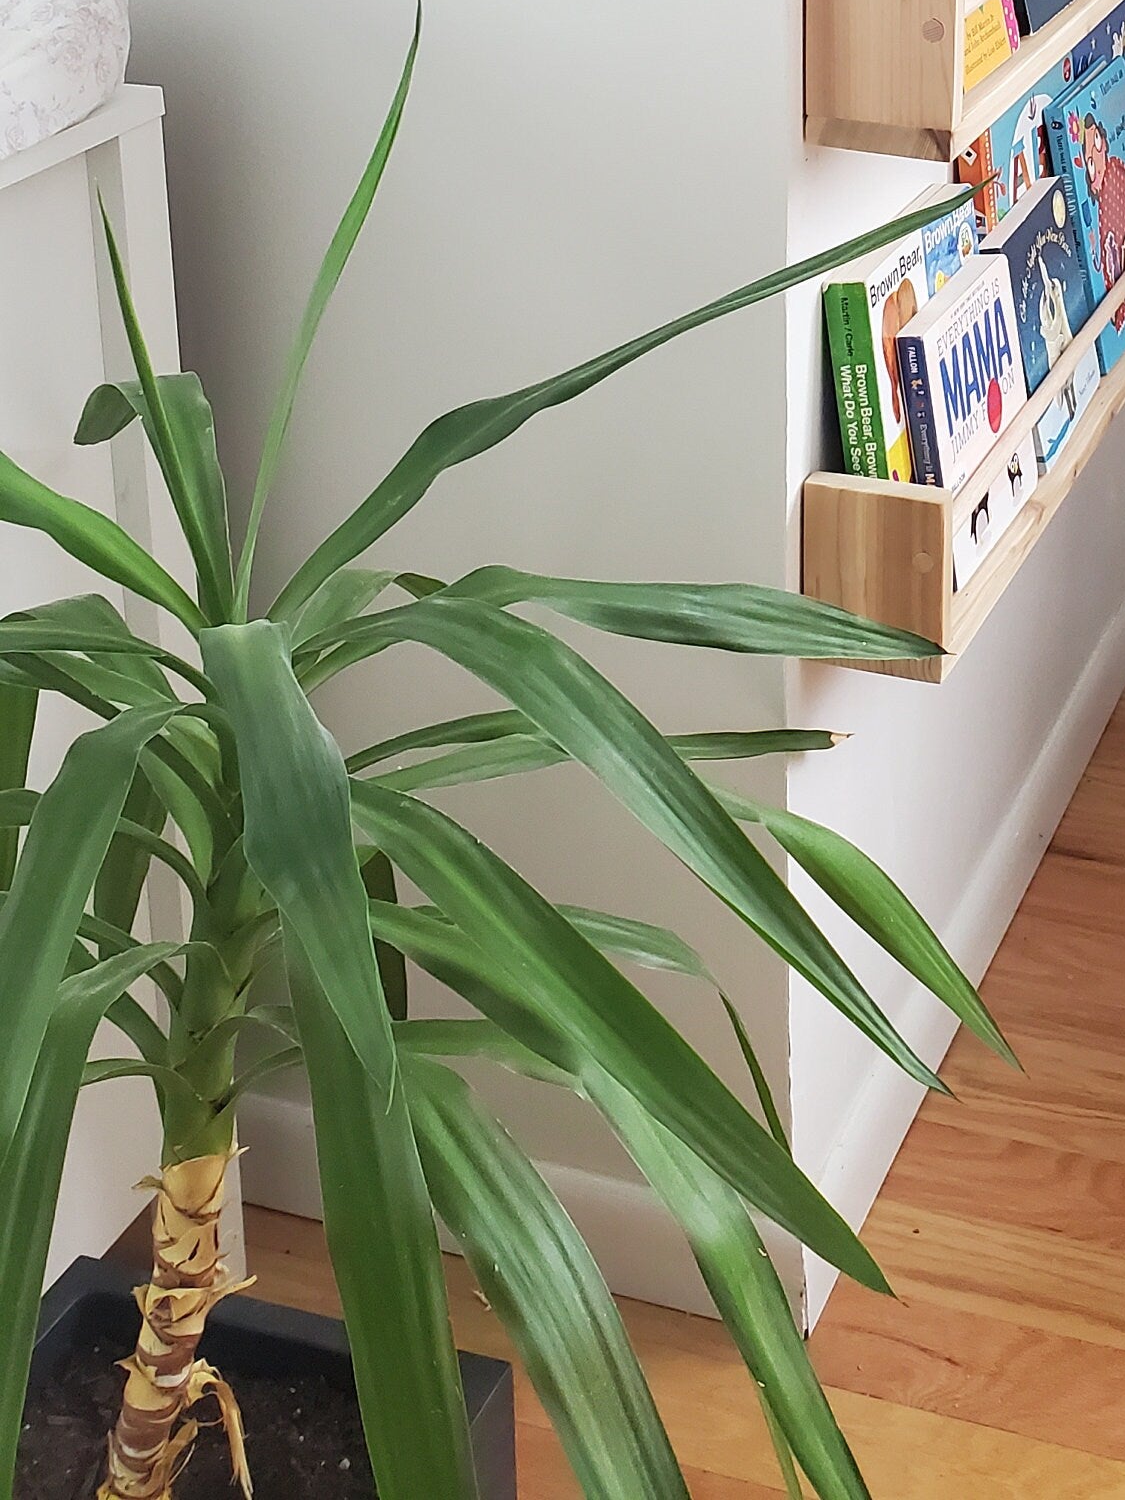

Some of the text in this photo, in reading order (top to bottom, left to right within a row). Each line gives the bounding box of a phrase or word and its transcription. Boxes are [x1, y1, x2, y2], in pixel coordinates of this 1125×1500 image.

[923, 218, 953, 255] Brown
[870, 245, 923, 308] Brown Bear,
[841, 297, 851, 326] Martin
[936, 288, 990, 357] EVERYTHING
[992, 277, 1000, 298] IS
[908, 346, 918, 374] FALLON
[939, 297, 1013, 438] MAMA
[839, 365, 852, 397] What
[855, 364, 869, 406] Brown
[844, 400, 856, 419] Do
[860, 406, 874, 440] Bear,
[847, 421, 859, 445] You
[951, 410, 979, 464] JIMMY
